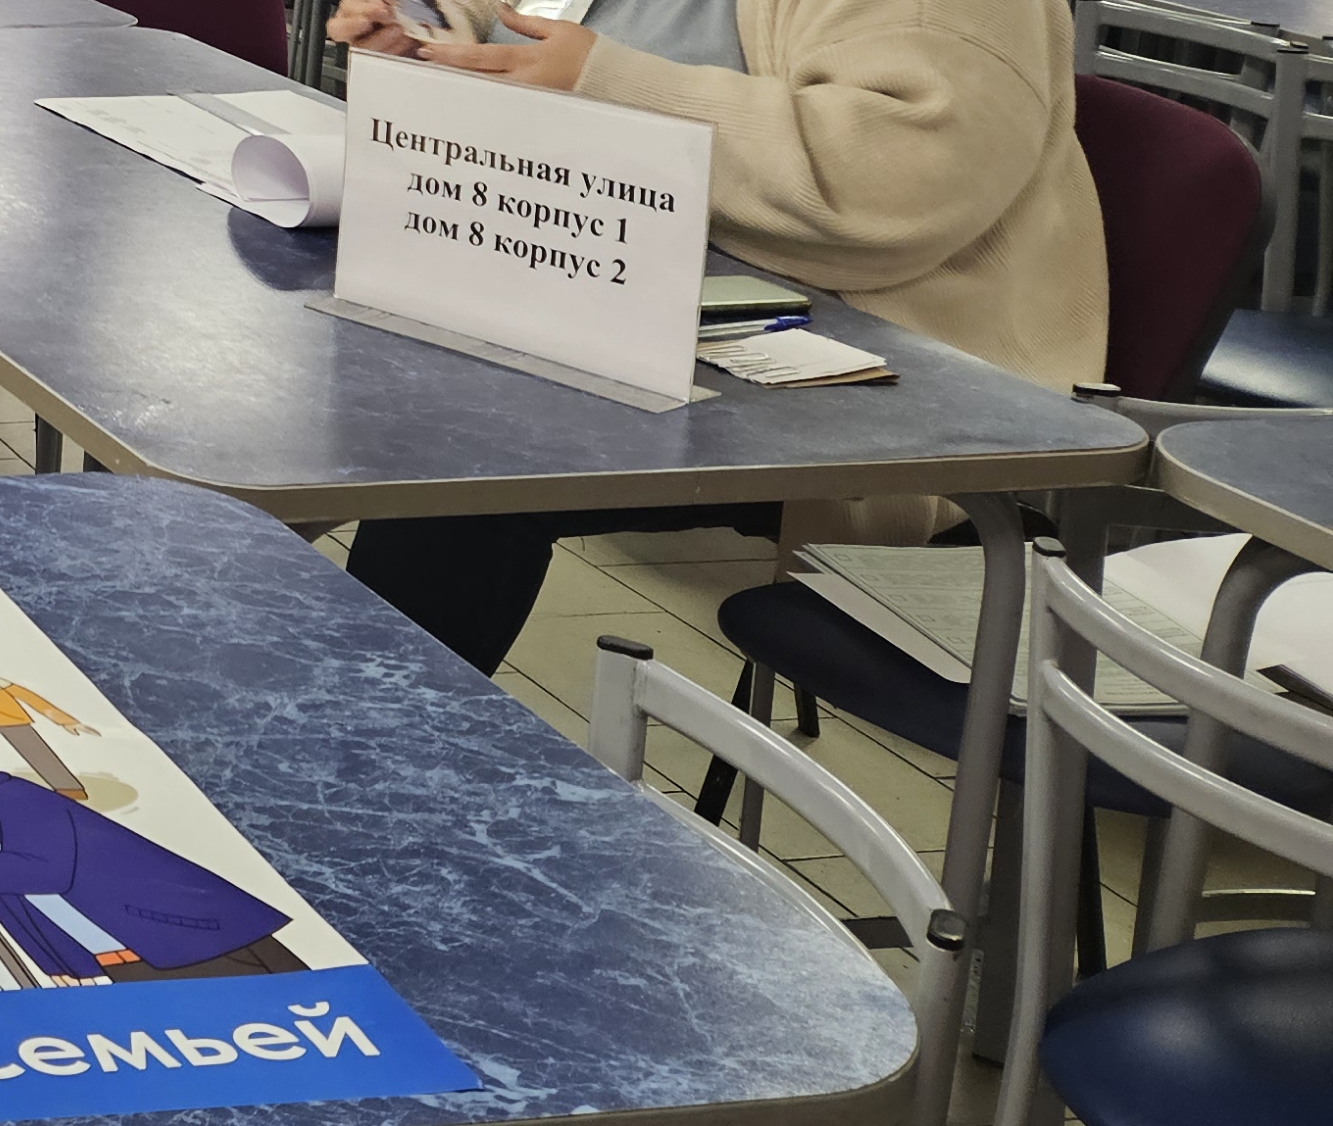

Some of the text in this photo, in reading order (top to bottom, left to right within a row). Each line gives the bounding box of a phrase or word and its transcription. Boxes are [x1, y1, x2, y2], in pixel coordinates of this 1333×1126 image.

[370, 117, 675, 213] Центральная улица
[407, 173, 629, 245] дом 8 корпус 1
[404, 211, 627, 286] дом 8 корпус 2
